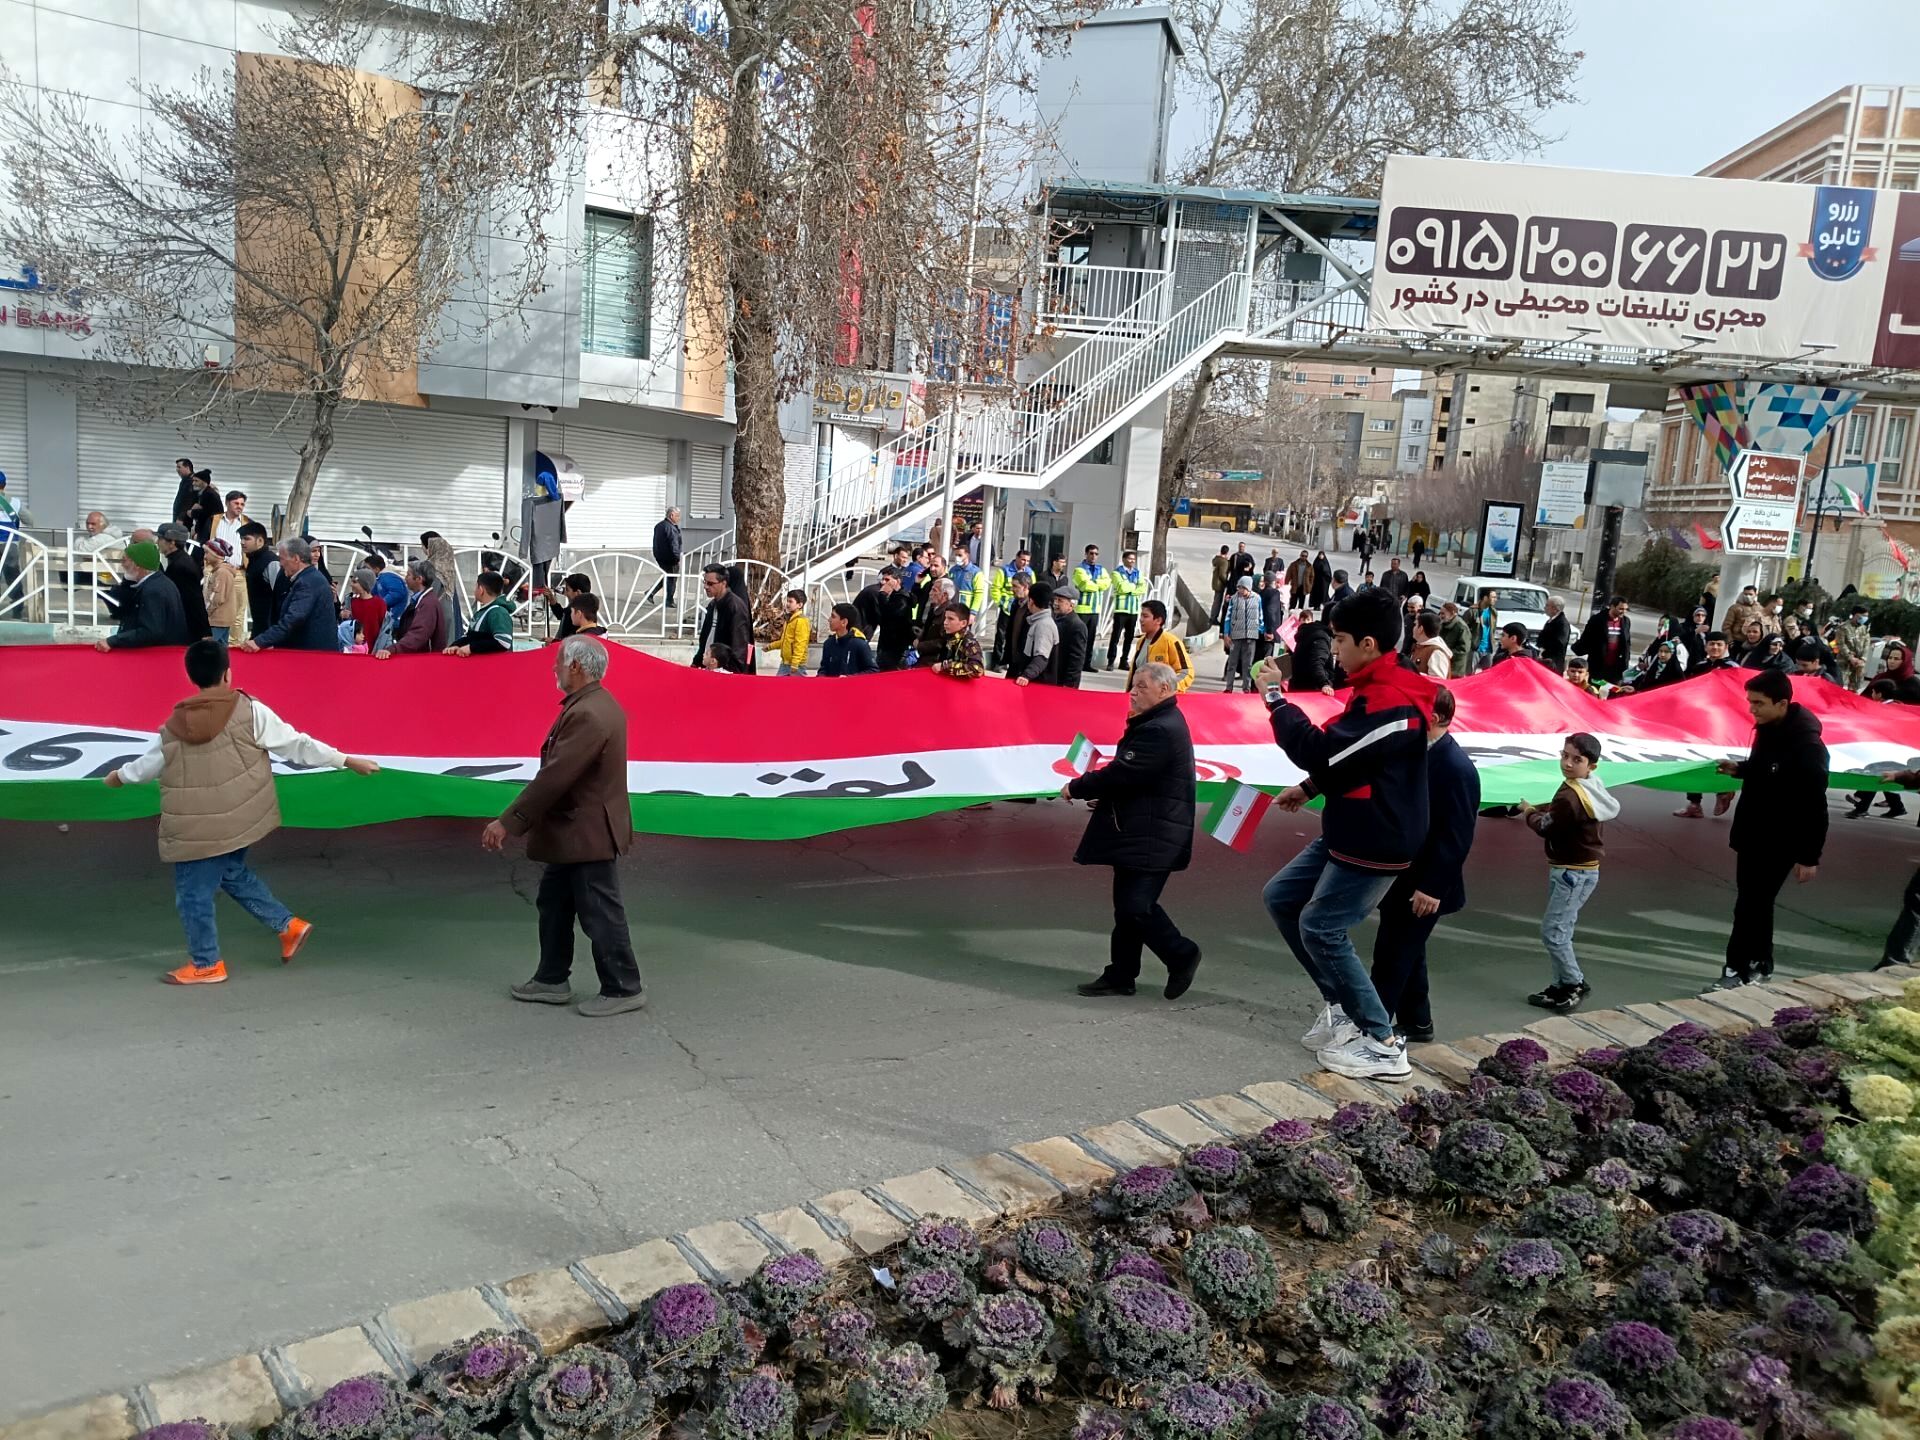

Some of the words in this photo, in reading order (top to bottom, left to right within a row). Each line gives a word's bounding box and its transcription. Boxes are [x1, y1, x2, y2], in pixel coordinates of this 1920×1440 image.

[1828, 200, 1860, 223] رزرو
[1818, 226, 1862, 251] تابلو
[1389, 217, 1508, 272] ۰۹۱۵
[1526, 225, 1607, 279] ۲۰۰
[1630, 231, 1701, 287] ۶۶
[1716, 239, 1782, 291] ۲۲
[1389, 277, 1459, 311] کشور
[1461, 289, 1489, 315] در
[1494, 287, 1590, 319] محیطی
[15, 306, 92, 336] BANK
[1596, 295, 1690, 328] تبلیغات
[1693, 308, 1767, 333] مجری
